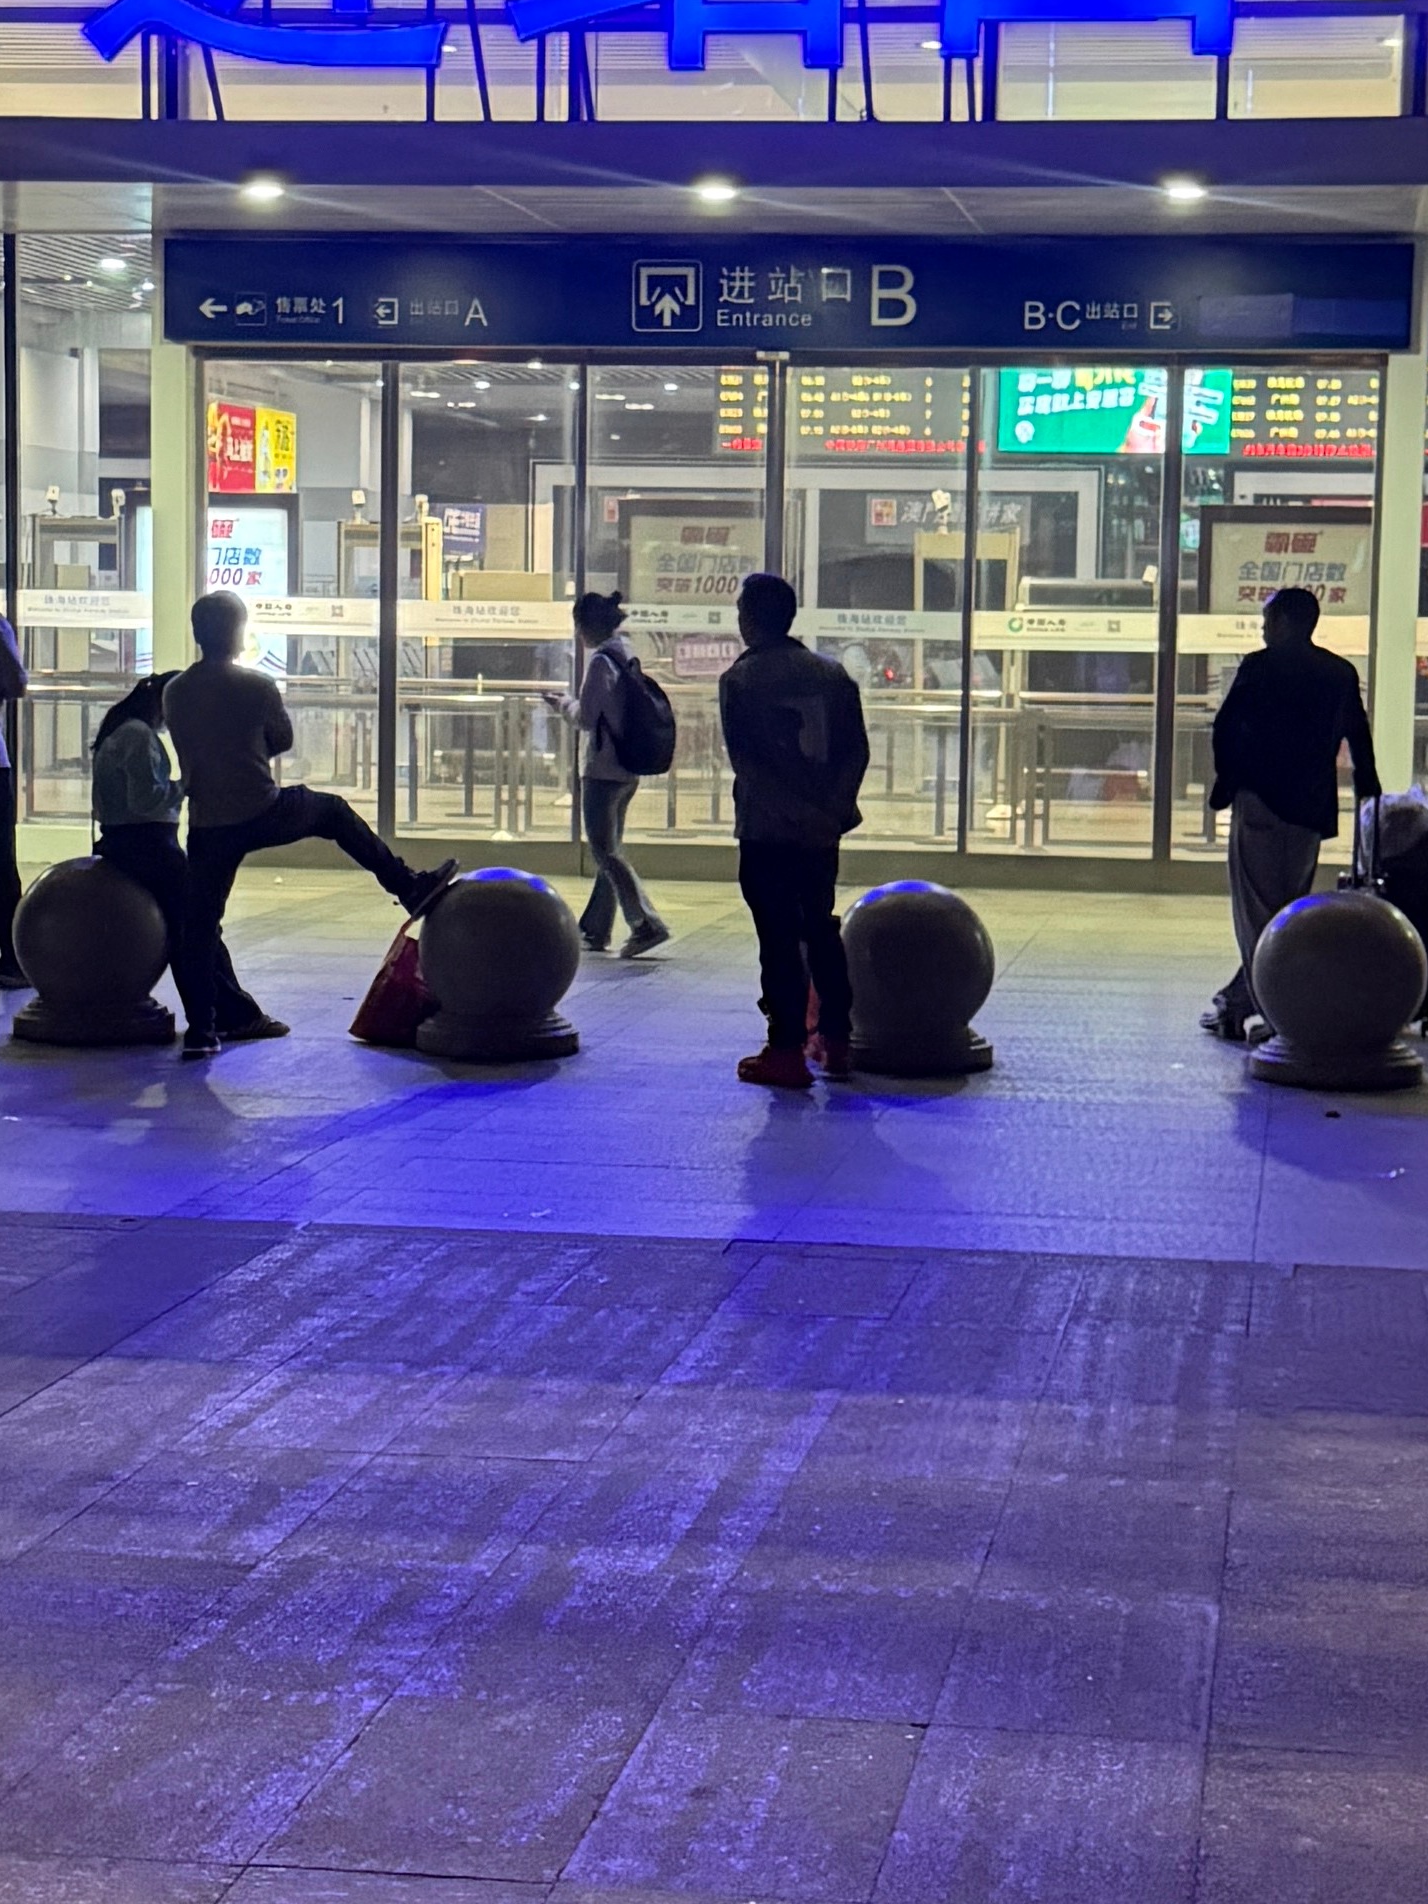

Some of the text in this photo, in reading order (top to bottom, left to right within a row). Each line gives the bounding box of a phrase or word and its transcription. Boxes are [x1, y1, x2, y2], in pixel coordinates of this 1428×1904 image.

[718, 264, 917, 328] 进站口 B
[332, 296, 345, 325] 1
[464, 298, 489, 326] A
[716, 309, 812, 328] Entrance
[1238, 560, 1347, 582] 全国门店数
